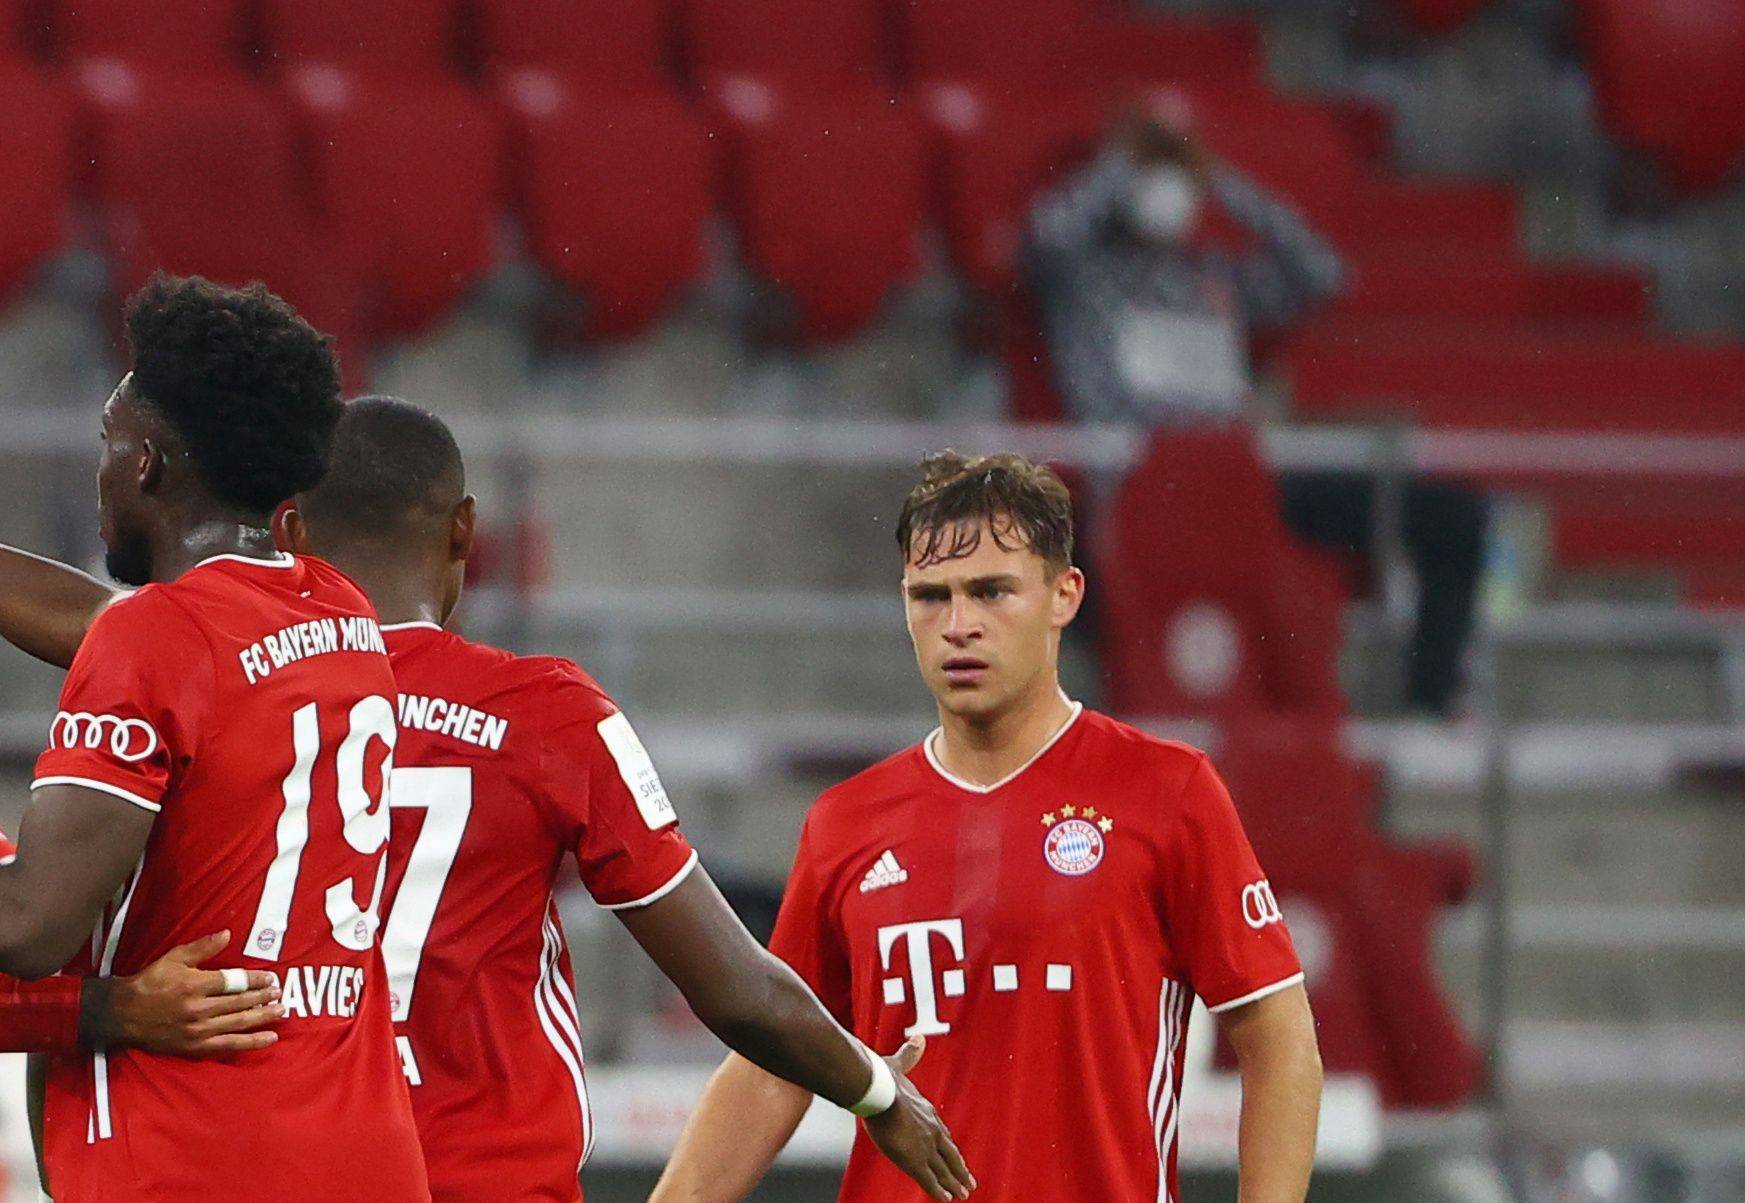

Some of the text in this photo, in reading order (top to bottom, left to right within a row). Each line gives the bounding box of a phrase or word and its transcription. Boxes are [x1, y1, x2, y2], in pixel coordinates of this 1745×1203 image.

[239, 642, 270, 685] FC
[262, 617, 339, 669] BAYERN
[243, 695, 398, 961] 19
